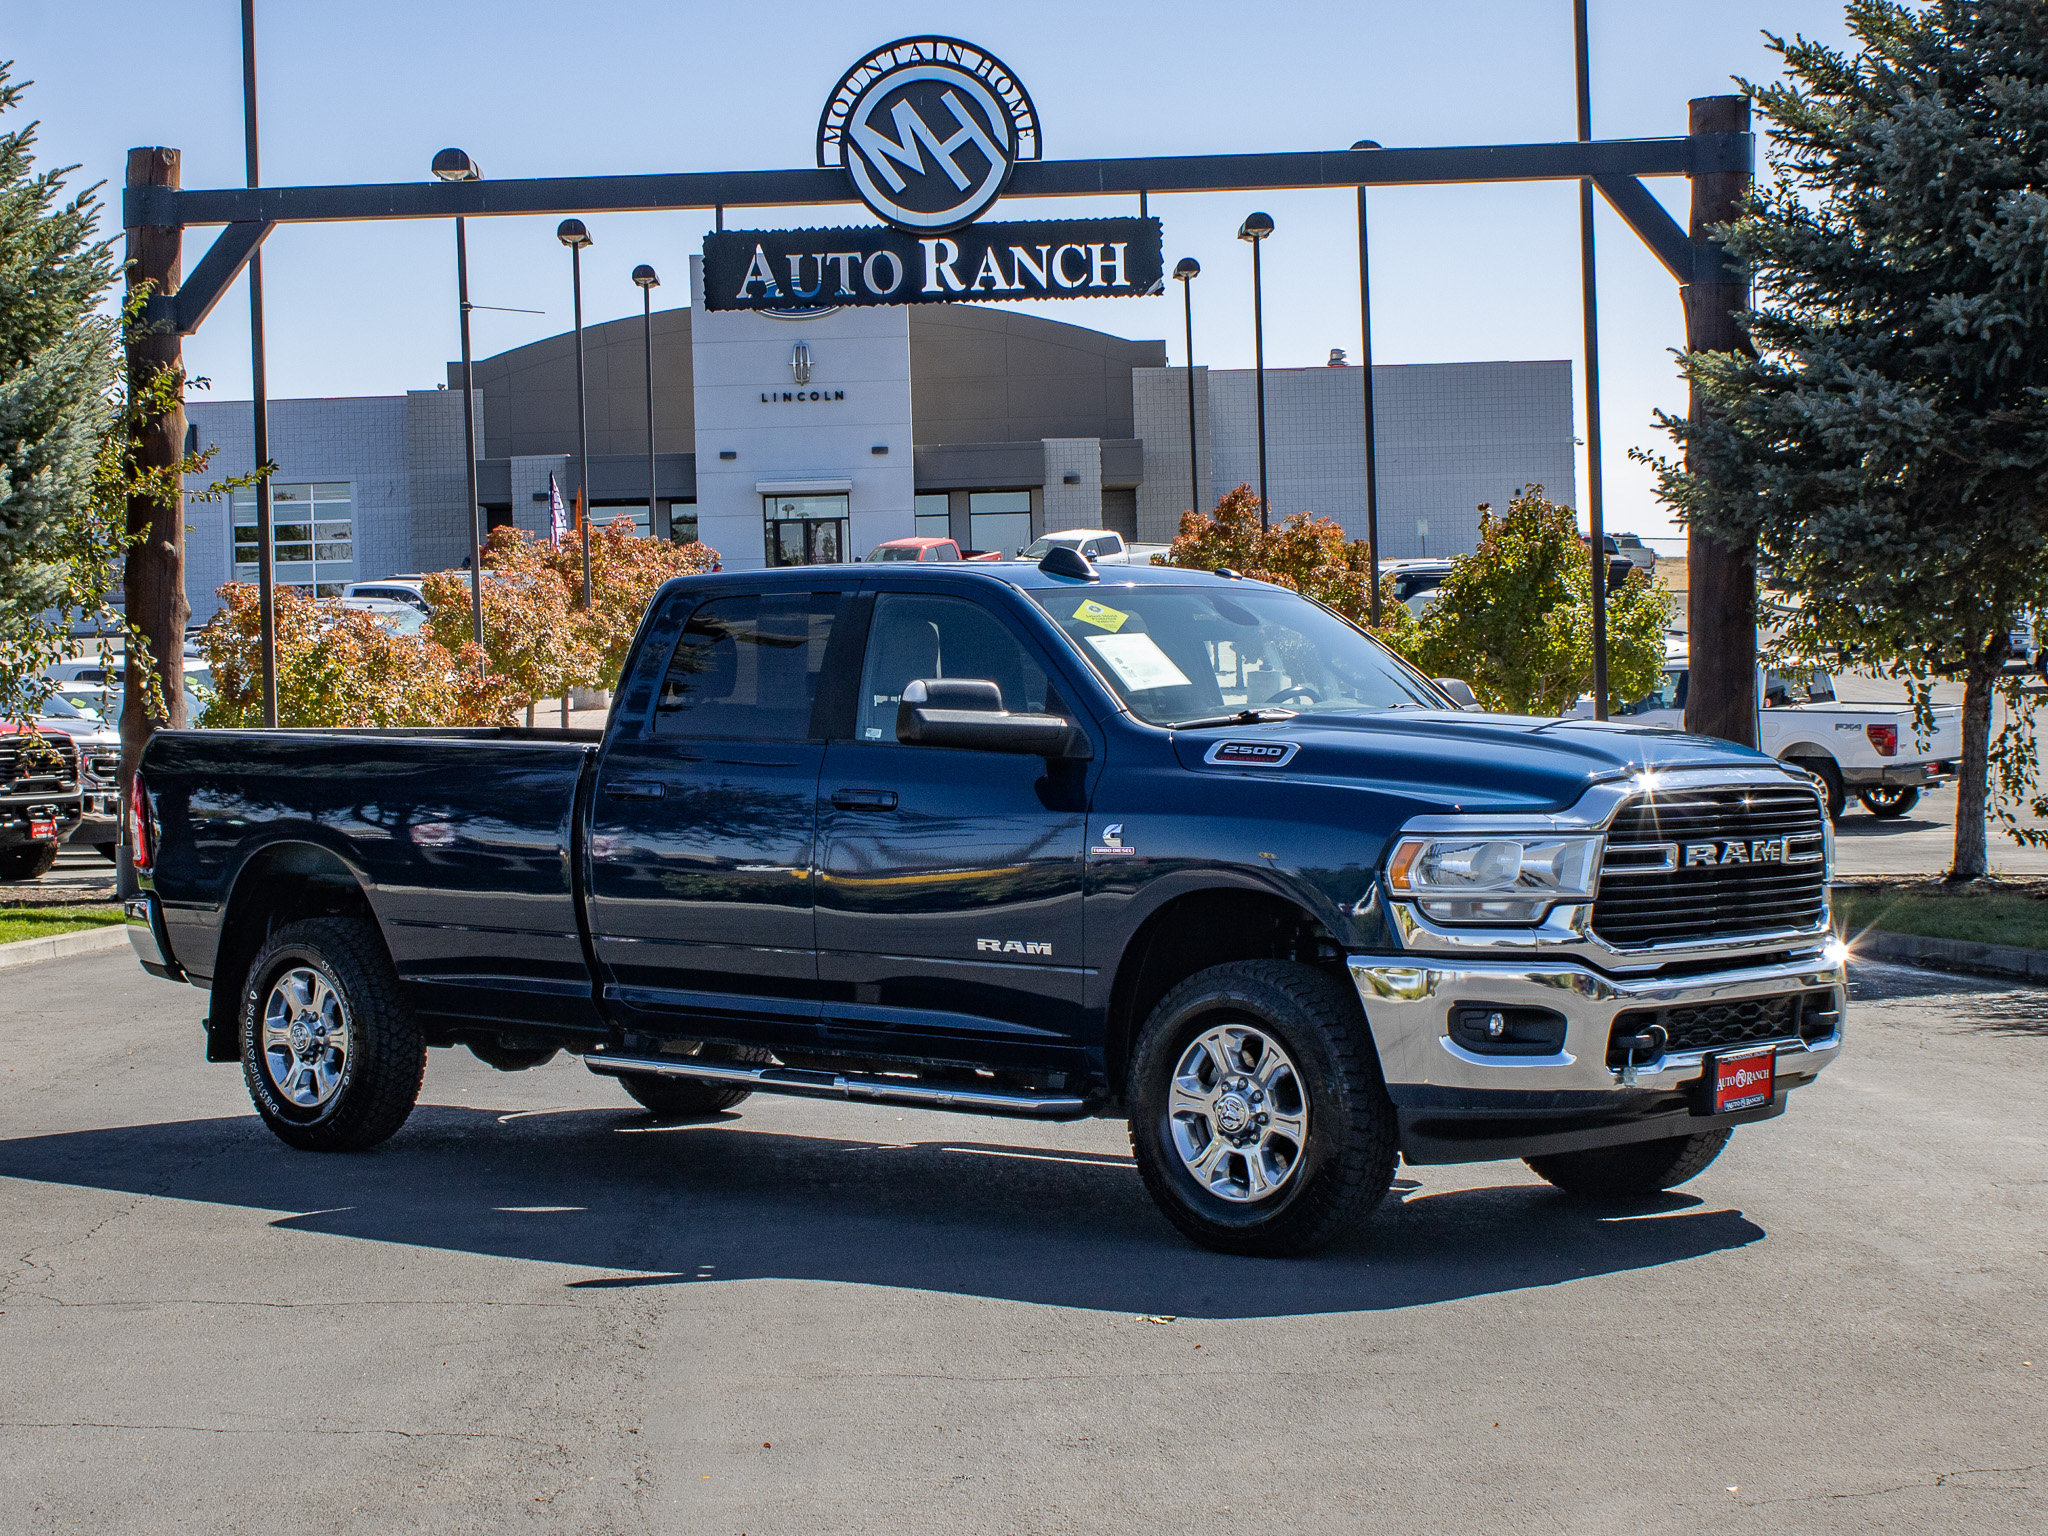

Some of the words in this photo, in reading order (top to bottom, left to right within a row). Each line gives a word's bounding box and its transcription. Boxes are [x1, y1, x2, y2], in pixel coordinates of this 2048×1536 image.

[824, 41, 963, 146] MOUNTAIN
[974, 58, 1036, 142] HOME
[736, 243, 903, 300] AUTO
[919, 237, 1132, 294] RANCH
[761, 389, 845, 404] LINCOLN
[1835, 723, 1863, 732] FX4
[1223, 745, 1282, 756] 2500
[1684, 839, 1782, 867] RAM
[976, 937, 1053, 956] RAM
[245, 1003, 281, 1115] DESTINATION
[1716, 1076, 1736, 1092] AUTO
[1746, 1069, 1769, 1086] RANCH
